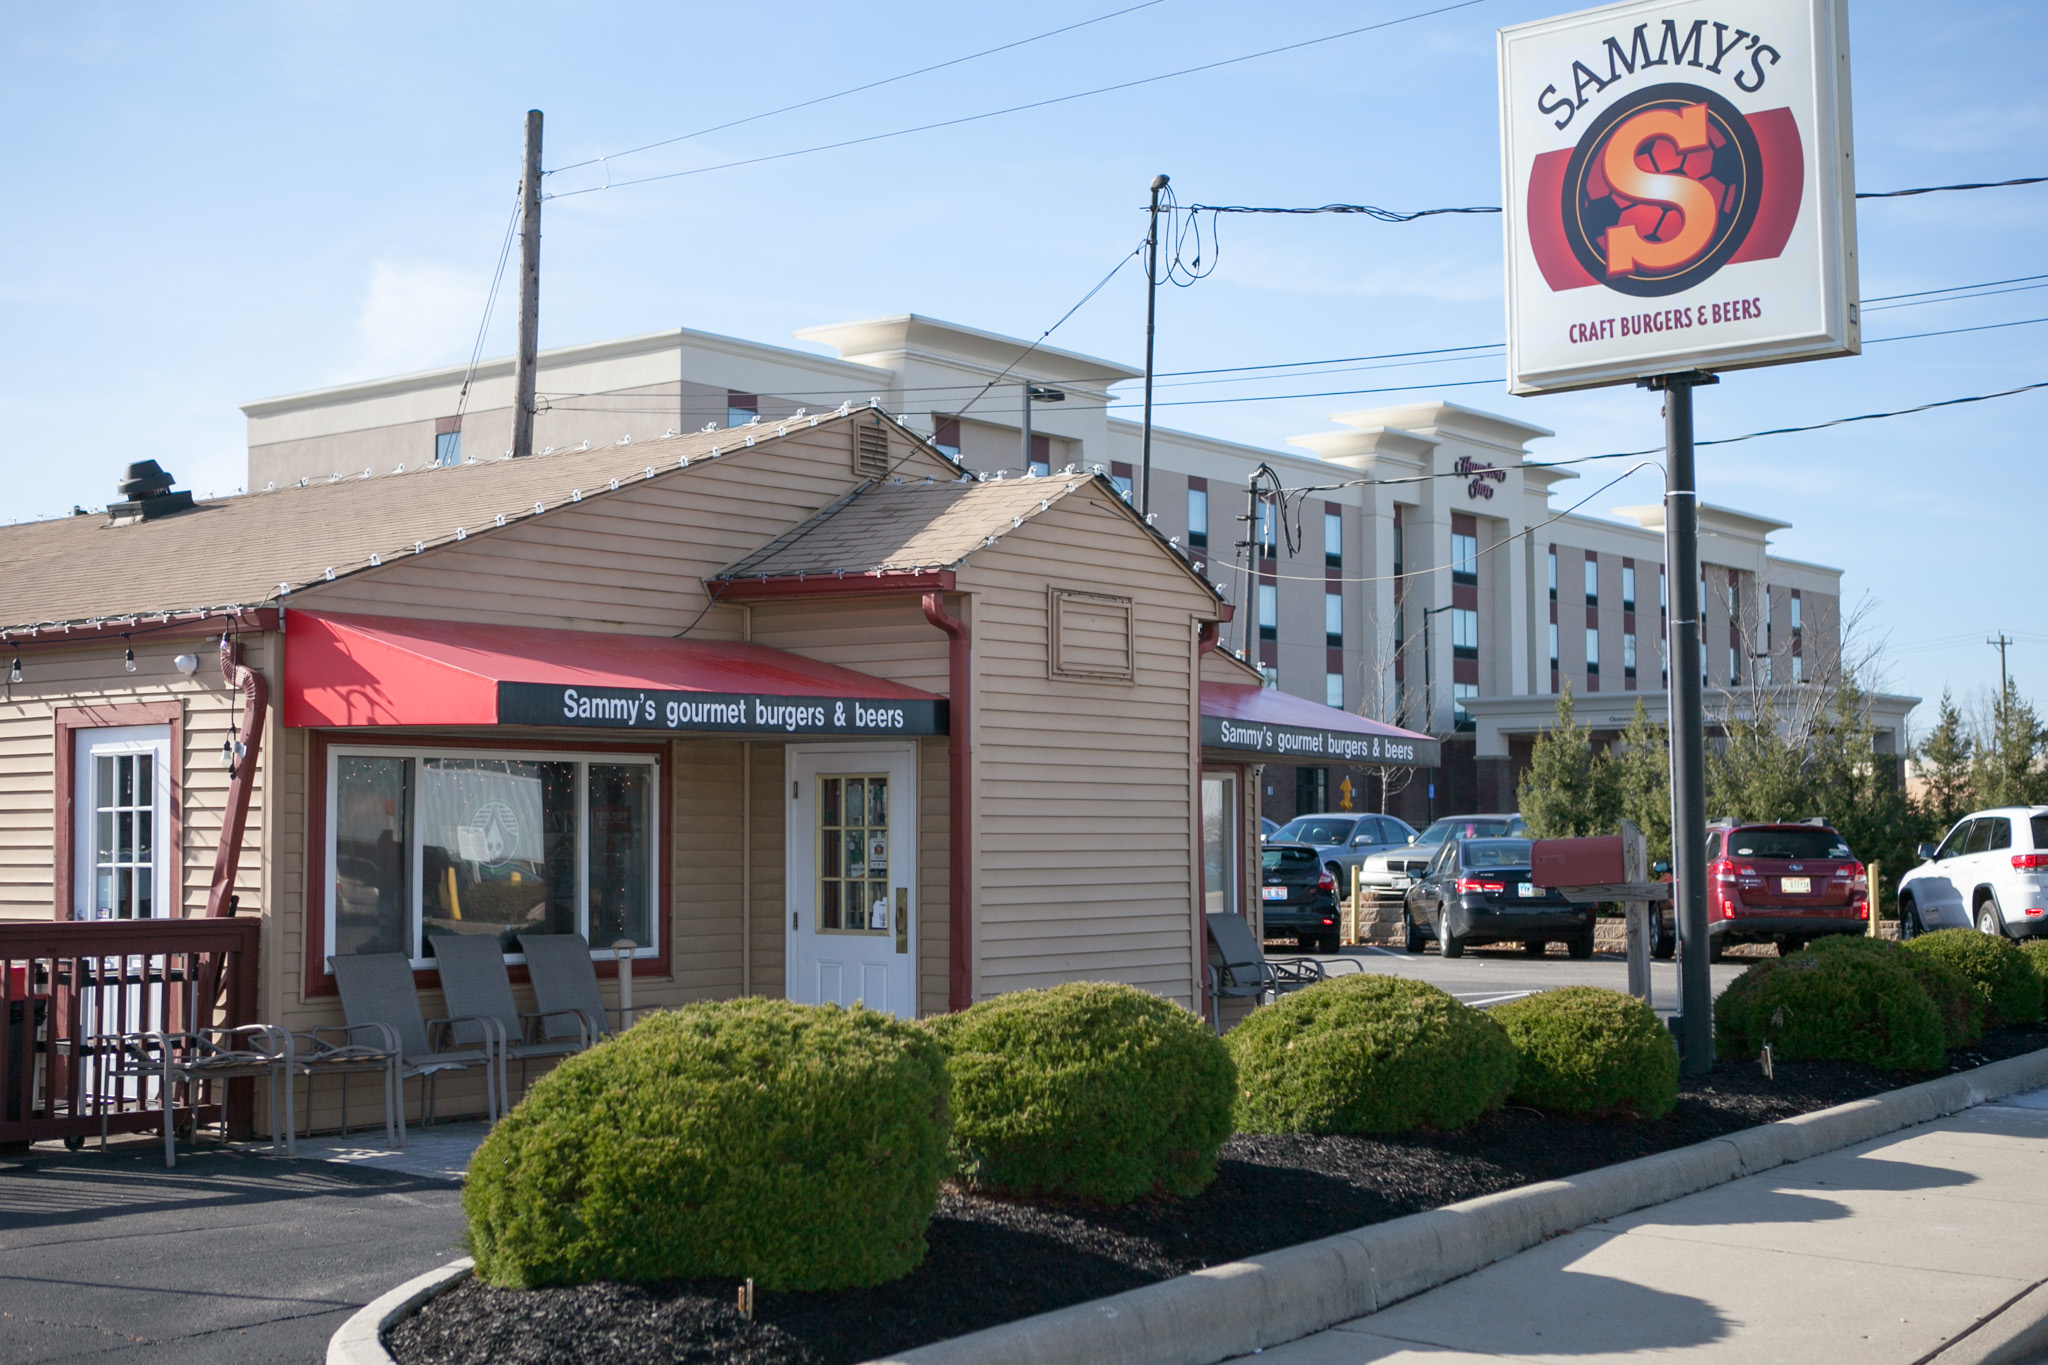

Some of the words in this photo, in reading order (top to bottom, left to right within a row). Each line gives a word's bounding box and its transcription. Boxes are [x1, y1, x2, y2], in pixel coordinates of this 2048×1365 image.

[1537, 19, 1781, 131] SAMMY'S
[1602, 102, 1718, 277] S
[1569, 318, 1615, 344] CRAFT
[1621, 306, 1693, 338] BURGERS
[1697, 304, 1708, 326] &
[1712, 297, 1762, 325] BEERS
[563, 688, 656, 726] Sammy's
[666, 698, 747, 728] gourmet
[755, 699, 825, 732] burgers
[833, 701, 847, 727] &
[855, 702, 904, 728] beers
[1221, 720, 1273, 750] Sammy's
[1277, 732, 1323, 753] gourmet
[1328, 733, 1368, 760] burgers
[1372, 737, 1380, 757] &
[1385, 738, 1414, 761] beers
